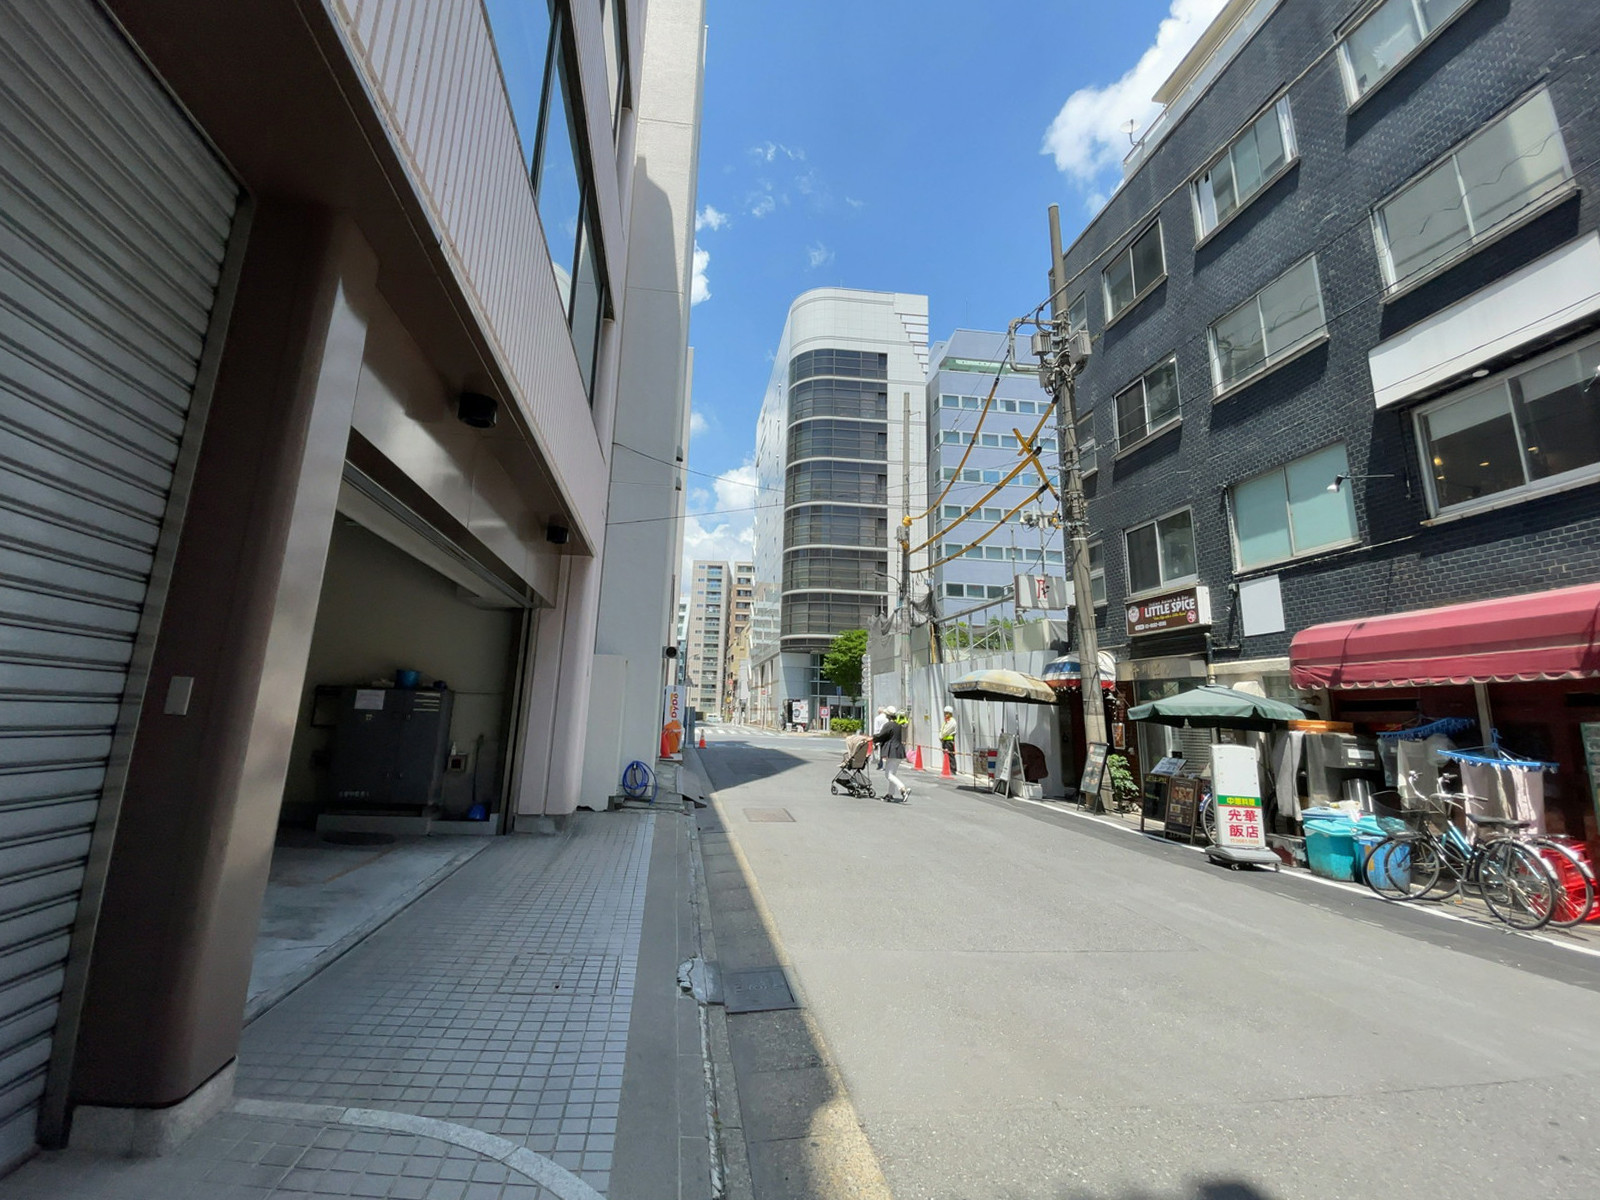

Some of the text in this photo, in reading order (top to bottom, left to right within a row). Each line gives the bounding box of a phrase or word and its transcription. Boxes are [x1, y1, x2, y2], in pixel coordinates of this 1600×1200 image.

[1144, 604, 1170, 618] LITTLE
[1172, 598, 1195, 612] SPICE
[1228, 809, 1258, 822] 光華
[1229, 824, 1259, 838] 飯店
